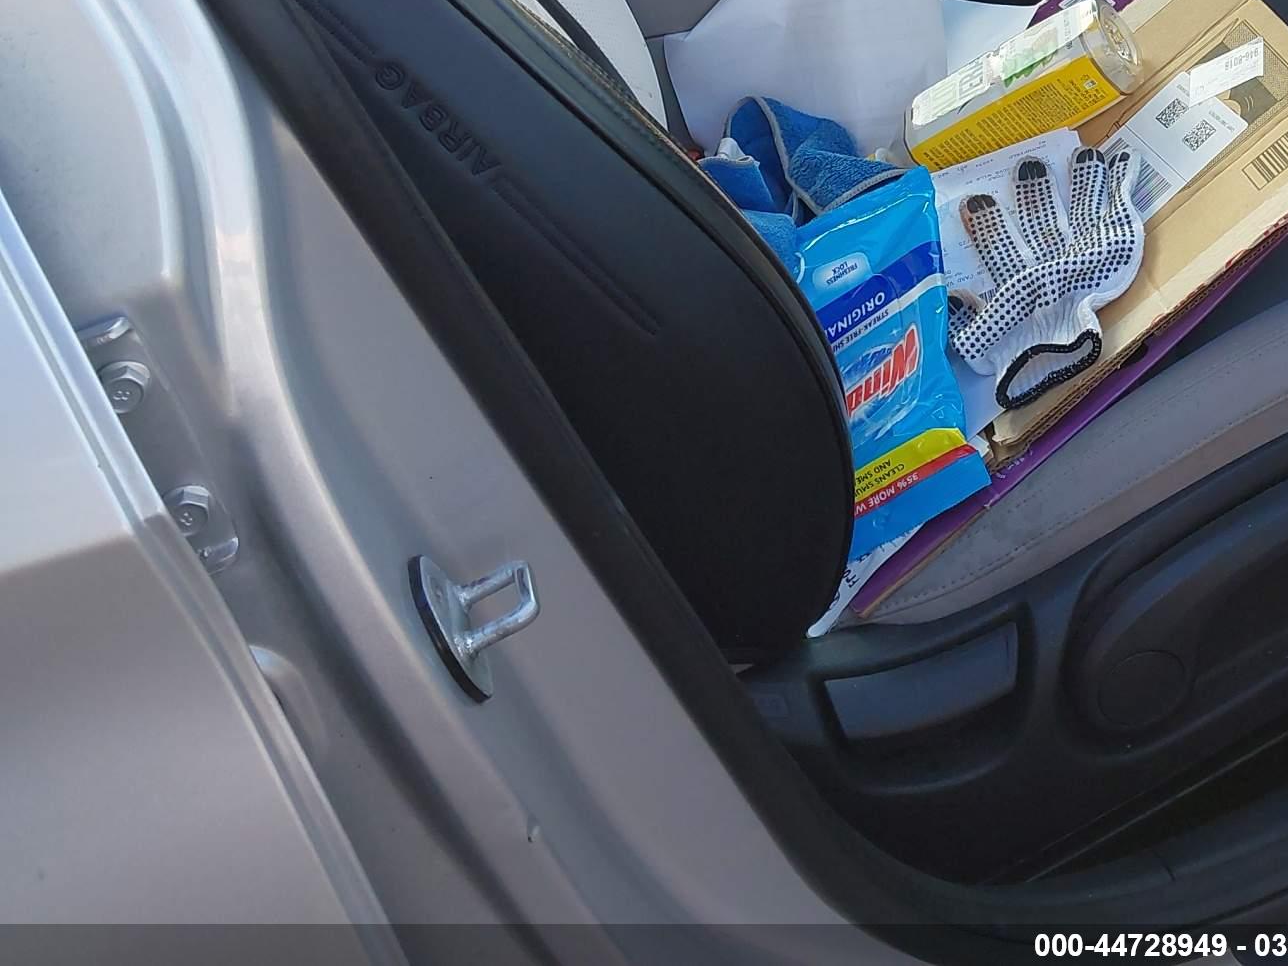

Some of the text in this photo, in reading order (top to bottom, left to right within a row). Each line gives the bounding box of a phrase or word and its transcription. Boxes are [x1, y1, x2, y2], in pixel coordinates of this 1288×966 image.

[375, 61, 501, 176] AIRBAG
[826, 262, 858, 285] FRESHNESS
[832, 261, 848, 275] LOCK
[874, 458, 891, 474] AND
[875, 463, 905, 488] CLEANS
[897, 472, 919, 490] 35%
[868, 486, 896, 507] MORE
